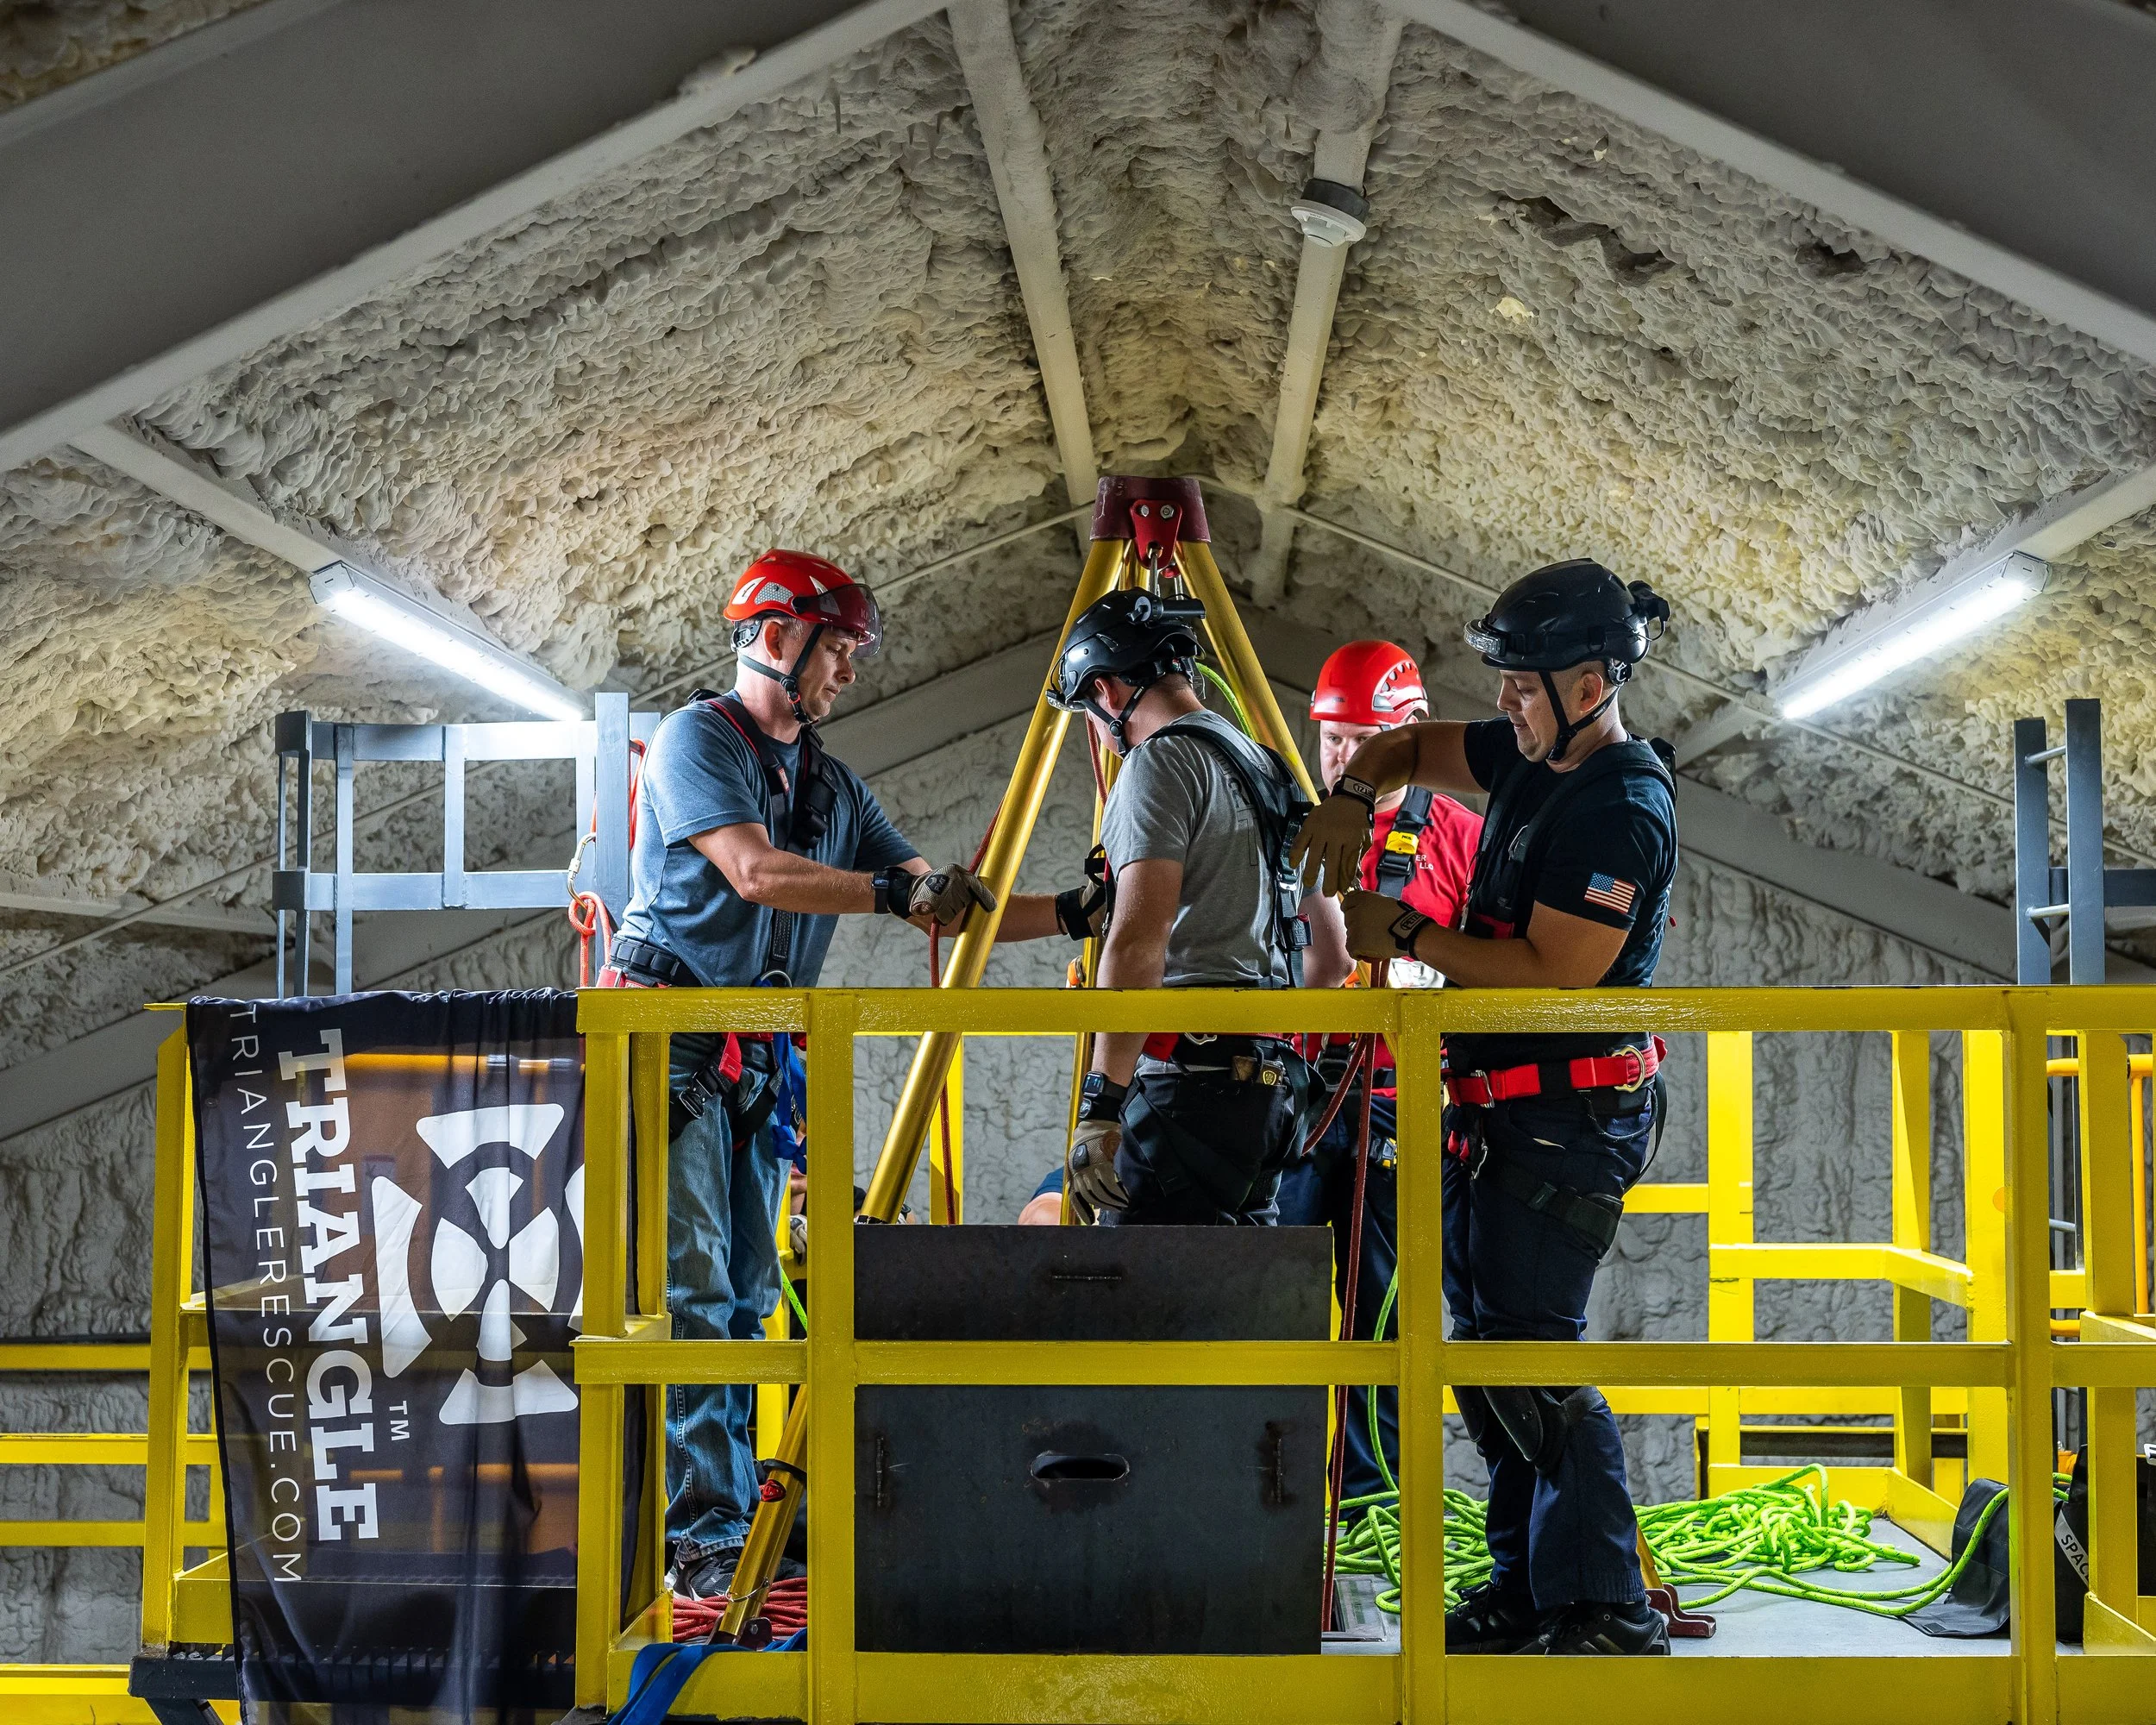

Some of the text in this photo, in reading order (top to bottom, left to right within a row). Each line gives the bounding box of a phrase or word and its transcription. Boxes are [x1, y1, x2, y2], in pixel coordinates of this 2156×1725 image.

[229, 1003, 302, 1581] TRIANGLERESCUE.COM
[278, 1028, 379, 1541] TRIANGLE
[2060, 1534, 2089, 1582] SPAC
